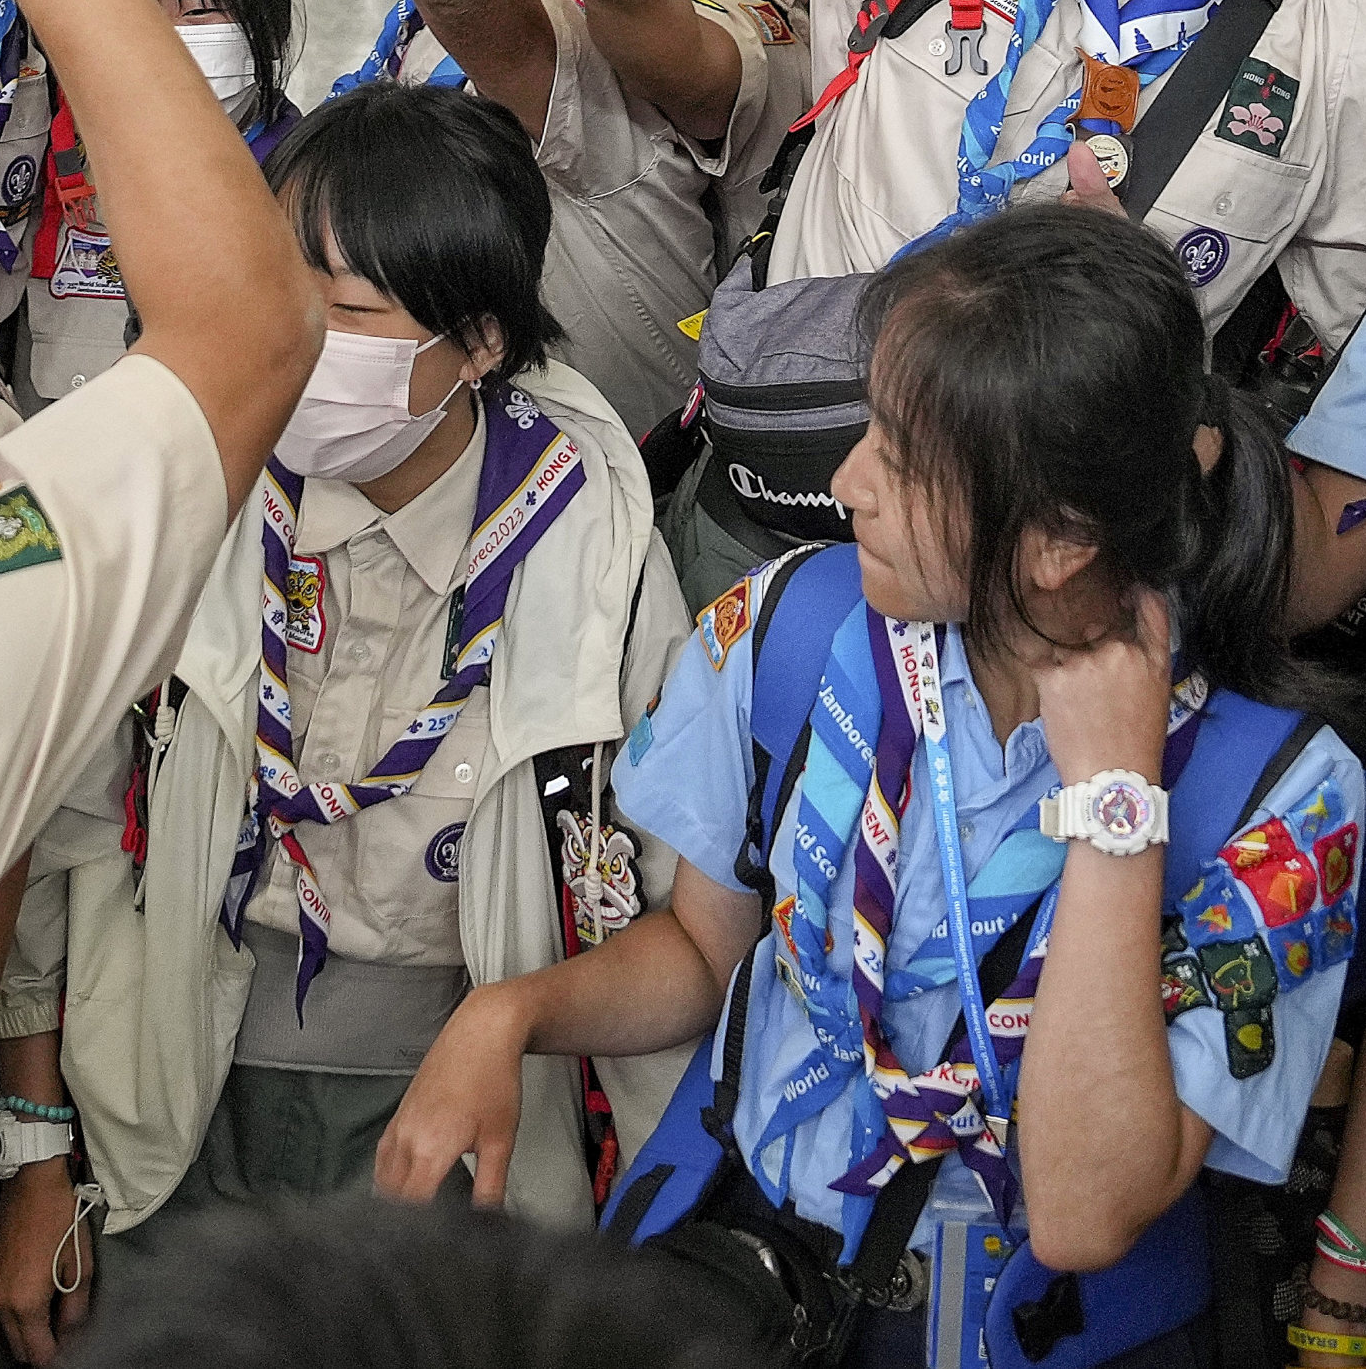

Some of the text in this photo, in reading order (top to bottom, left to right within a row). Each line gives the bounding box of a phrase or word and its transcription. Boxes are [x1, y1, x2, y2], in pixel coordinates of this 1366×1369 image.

[1242, 71, 1266, 85] HONG
[1270, 84, 1291, 100] KONG
[536, 451, 571, 491] HONG
[783, 1062, 831, 1104] World
